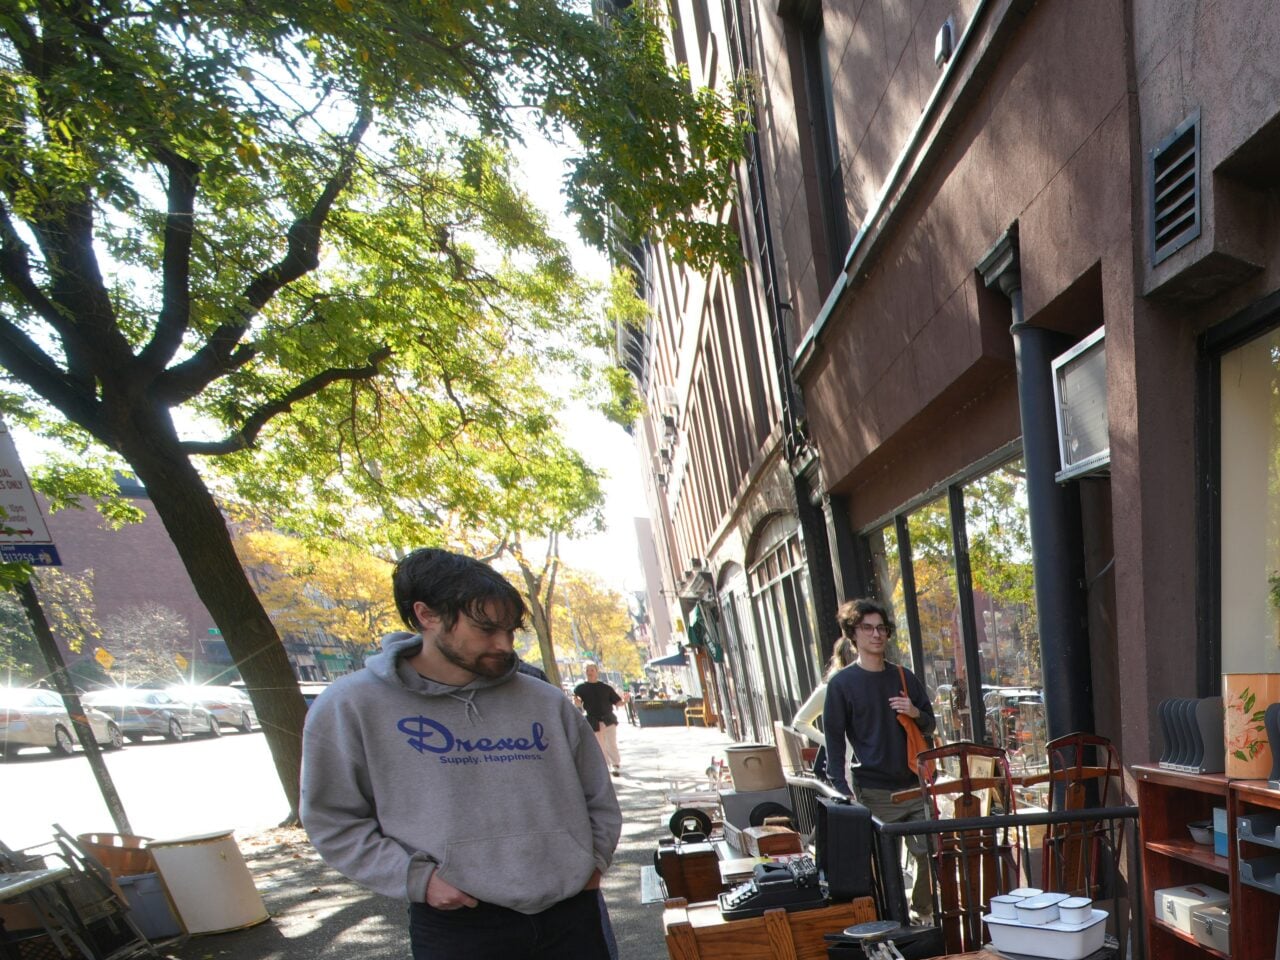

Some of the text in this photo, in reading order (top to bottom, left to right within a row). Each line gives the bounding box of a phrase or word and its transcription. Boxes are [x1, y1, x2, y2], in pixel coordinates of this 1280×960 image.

[397, 715, 549, 754] Drexel
[440, 753, 544, 765] Supply. Happiness.
